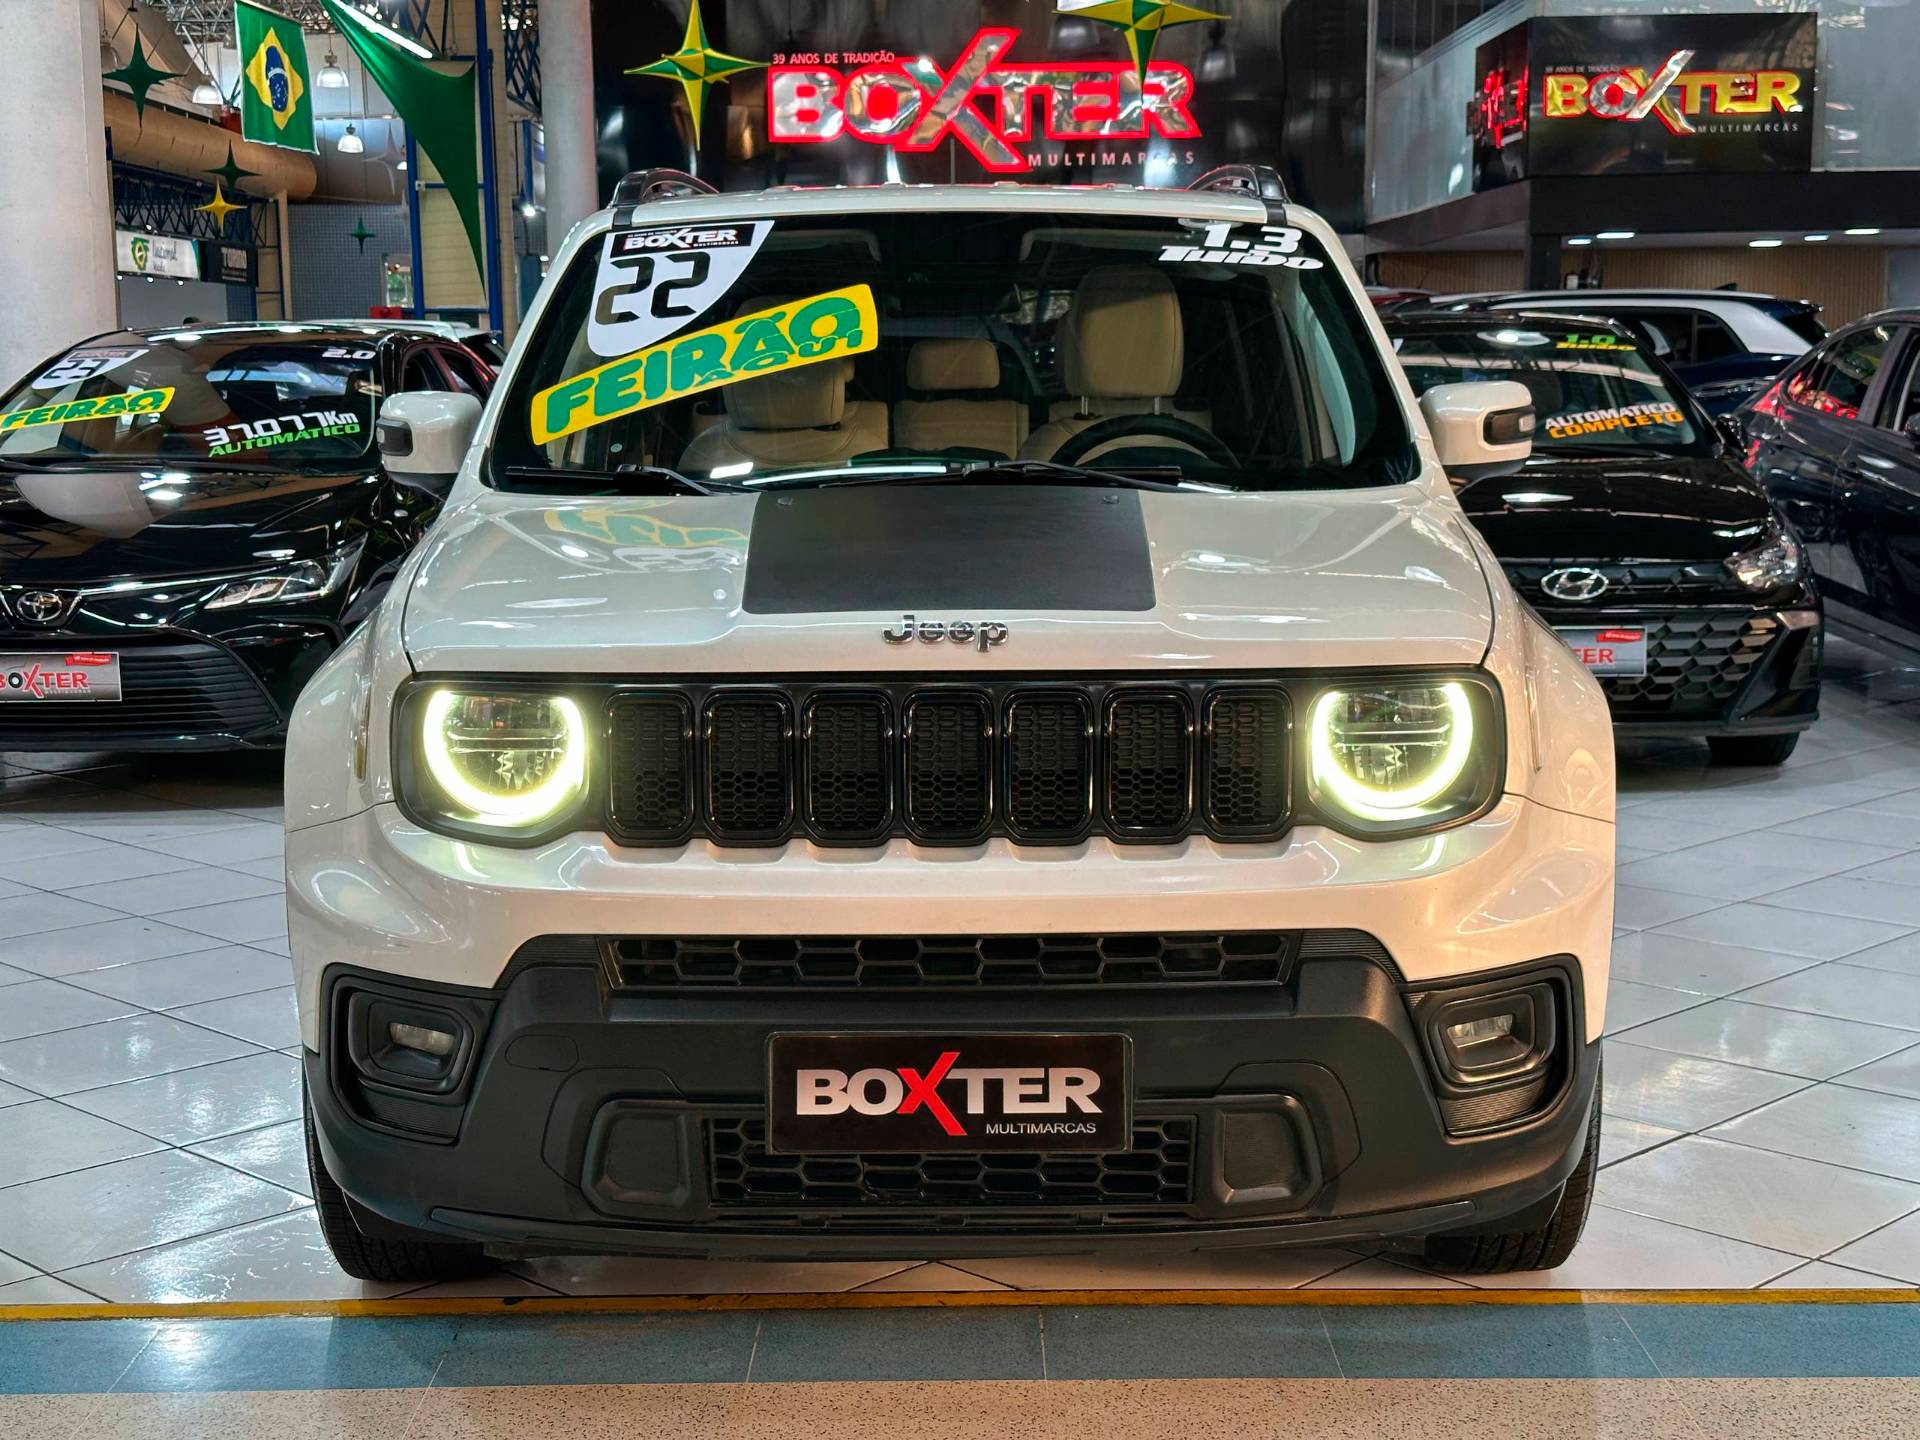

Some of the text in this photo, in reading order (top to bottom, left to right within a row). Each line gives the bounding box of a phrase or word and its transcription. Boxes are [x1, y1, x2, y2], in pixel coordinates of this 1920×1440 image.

[772, 49, 895, 65] 39 ANOS DE TRADIÇÃO
[768, 28, 1202, 173] BOXTER
[1543, 49, 1804, 137] BOXTER
[1697, 122, 1800, 134] MULTIMARCAS
[1028, 151, 1197, 168] MULTIMARCAS
[624, 227, 738, 250] BOXTER
[1203, 222, 1303, 254] 1.3
[595, 251, 711, 326] 22
[321, 348, 377, 360] 2.0
[545, 296, 862, 434] FEIRÃO
[1545, 402, 1676, 429] AUTOMATICO
[1550, 411, 1684, 438] COMPLETO
[881, 613, 1009, 653] Jeep
[796, 1051, 1104, 1137] BOXTER
[985, 1122, 1097, 1135] MULTIMARCAS
